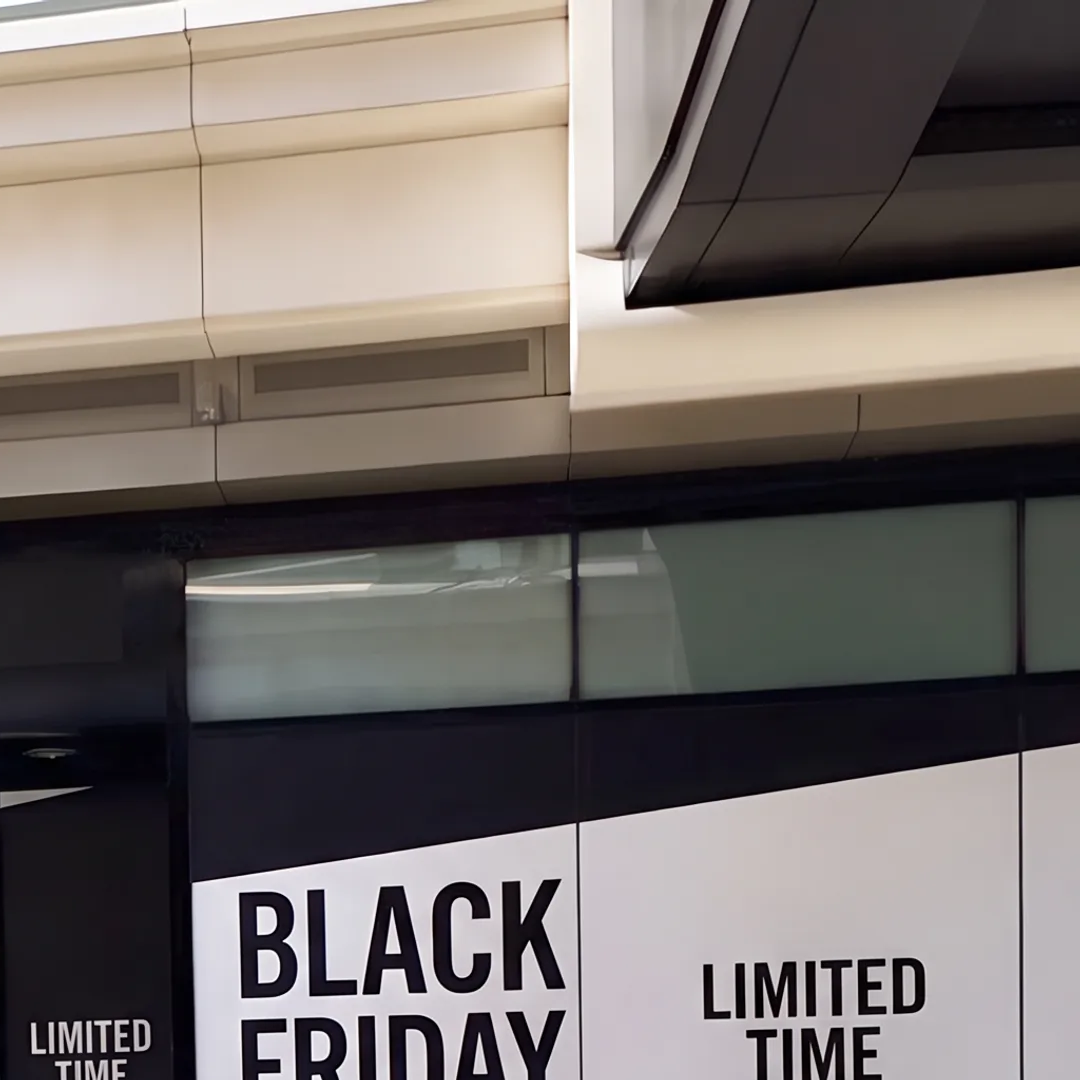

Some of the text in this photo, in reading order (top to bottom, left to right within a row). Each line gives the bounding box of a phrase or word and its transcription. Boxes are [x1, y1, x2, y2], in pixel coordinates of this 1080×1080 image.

[238, 878, 566, 999] BLACK
[703, 957, 926, 1020] LIMITED
[30, 1019, 151, 1055] LIMITED
